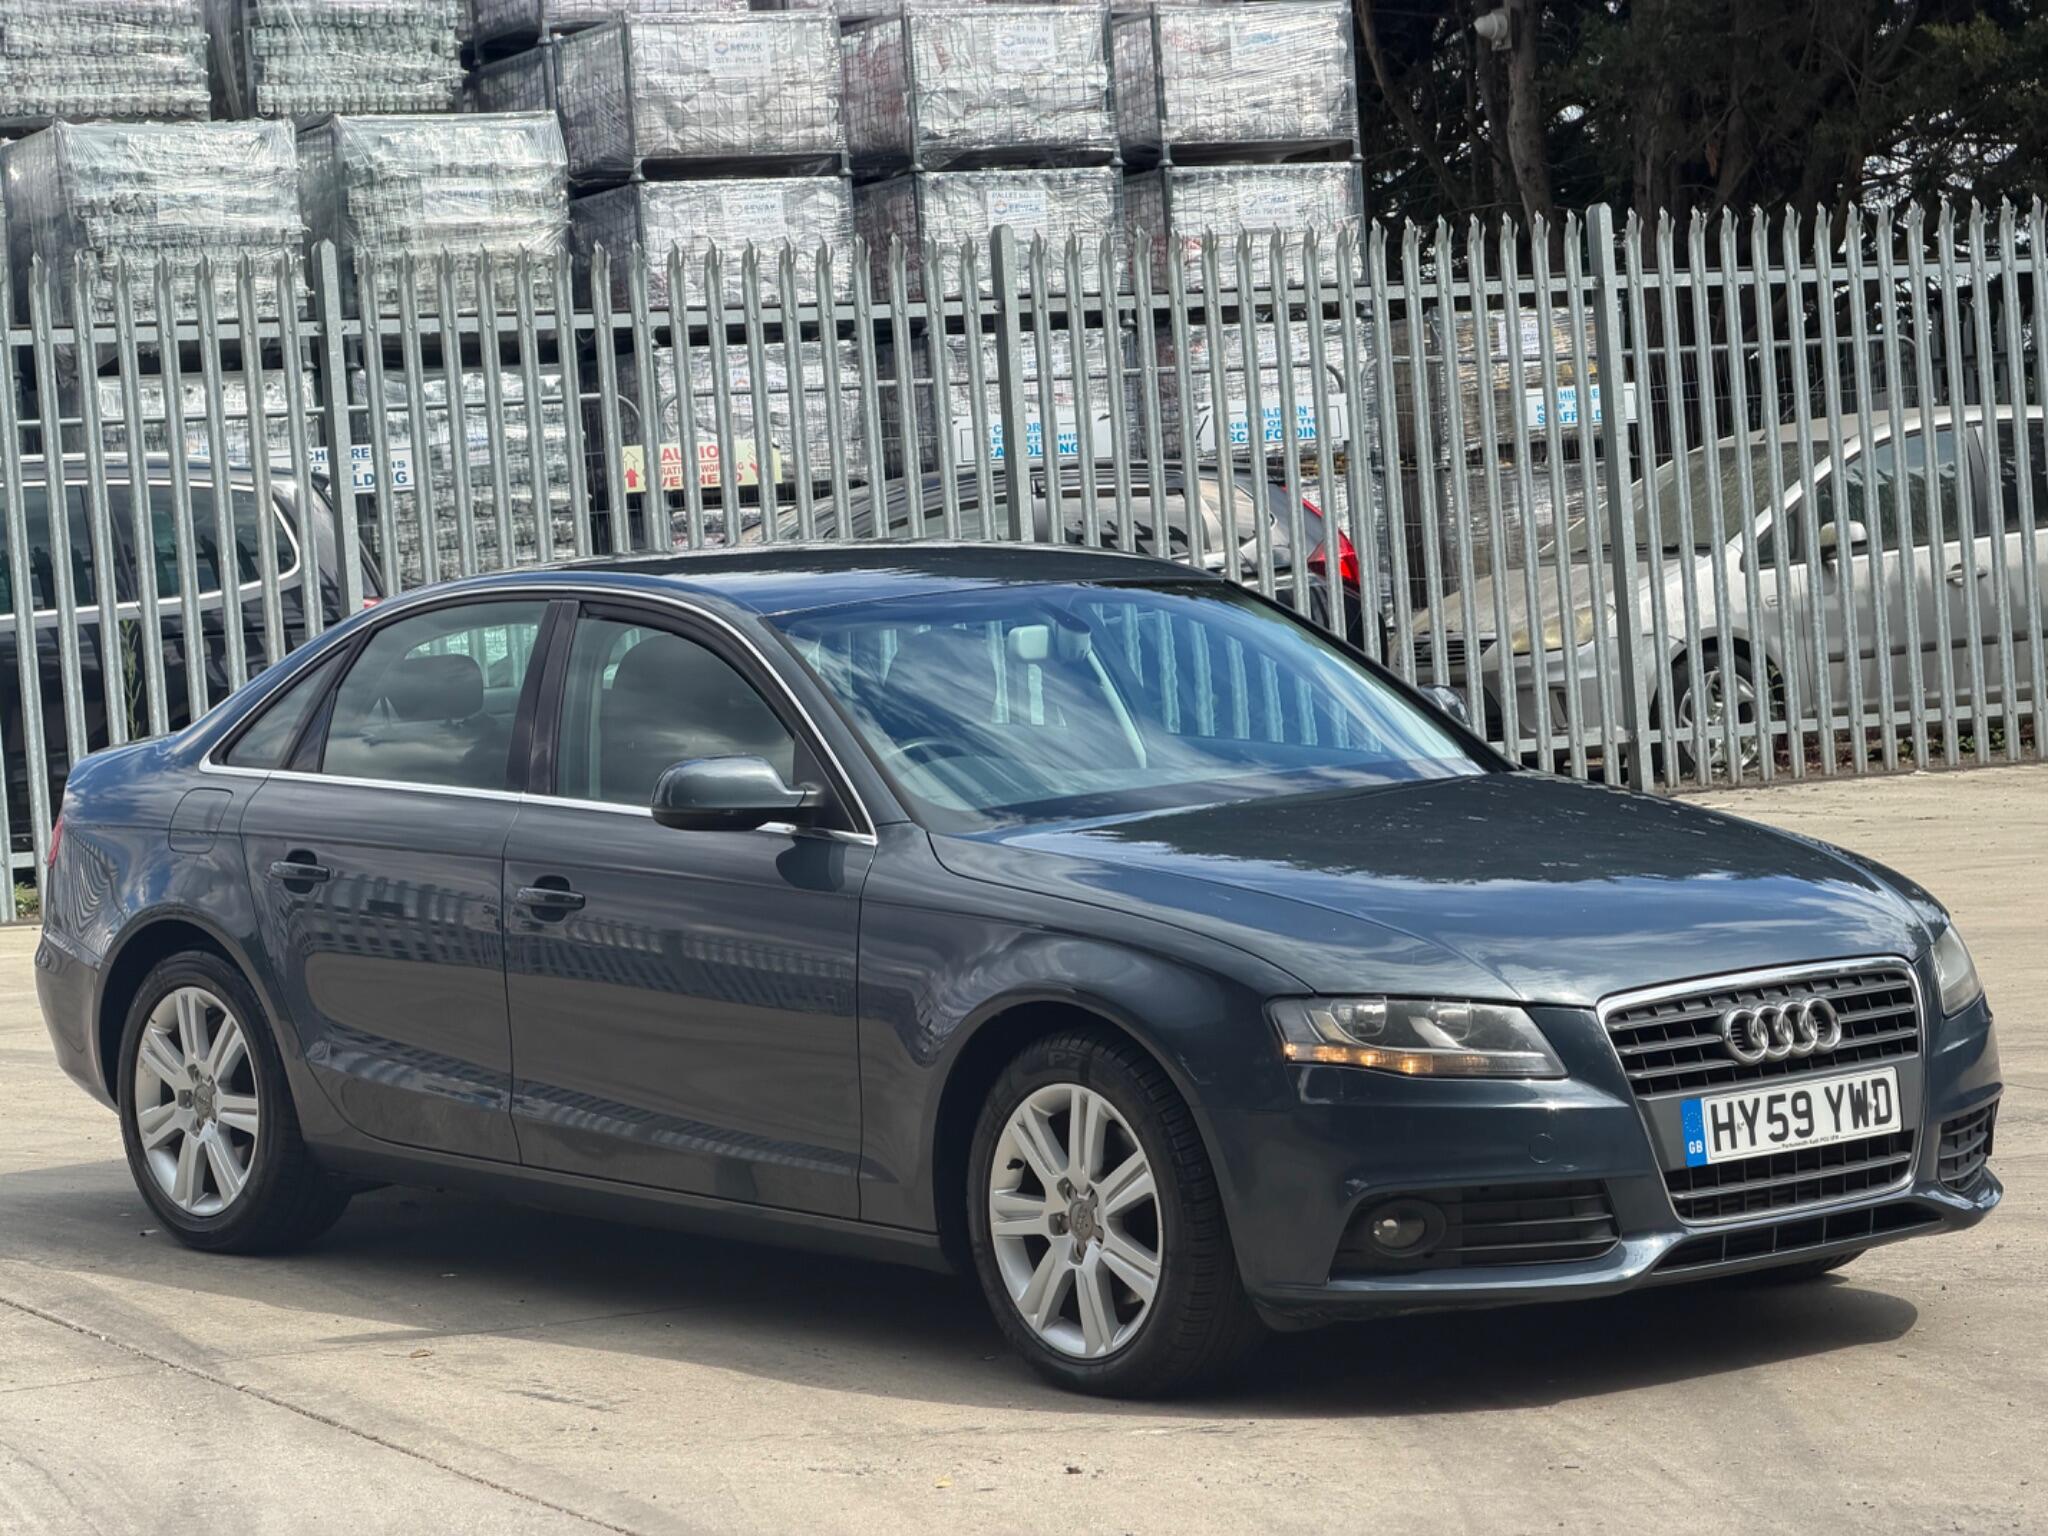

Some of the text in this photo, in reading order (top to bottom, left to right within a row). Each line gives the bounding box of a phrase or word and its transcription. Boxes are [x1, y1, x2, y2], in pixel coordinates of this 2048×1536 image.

[1688, 1077, 1893, 1154] GB HY59 YWD
